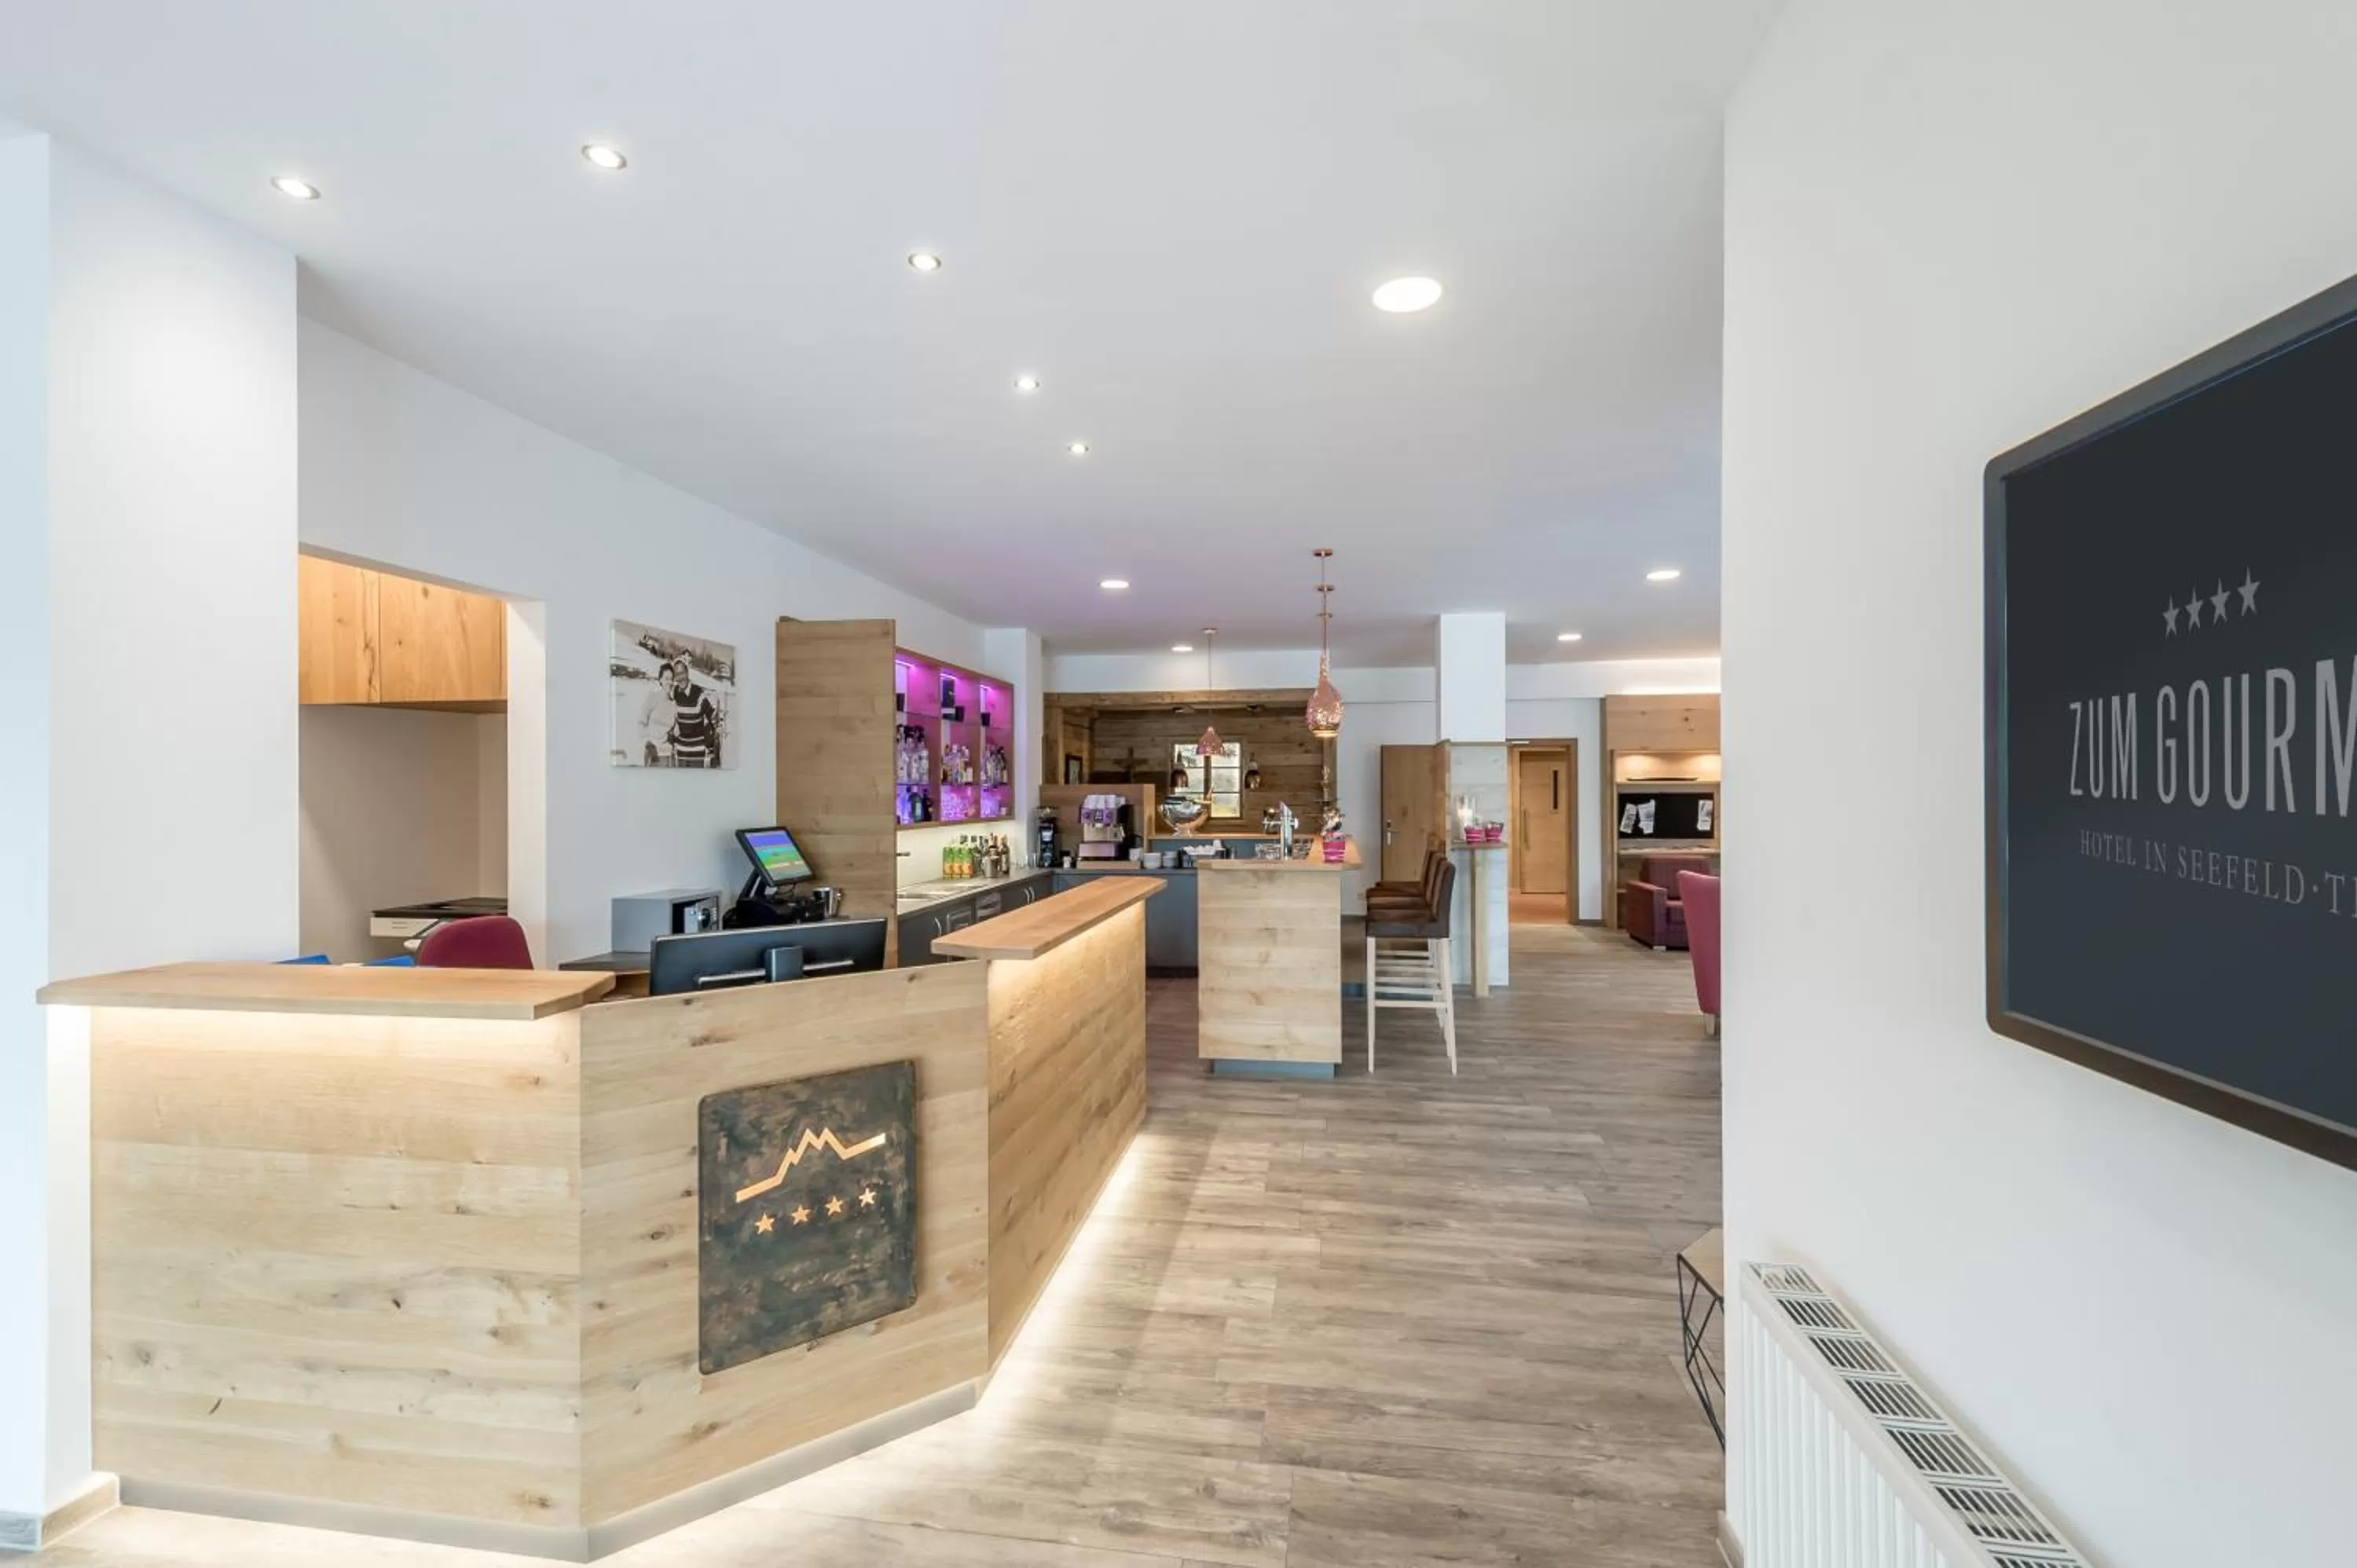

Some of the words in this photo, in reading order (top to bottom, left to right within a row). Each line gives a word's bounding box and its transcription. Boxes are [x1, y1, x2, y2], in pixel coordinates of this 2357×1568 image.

[2069, 692, 2138, 800] ZUM
[2157, 653, 2357, 817] GOURM
[2080, 830, 2136, 866] HOTEL
[2145, 841, 2167, 874] IN
